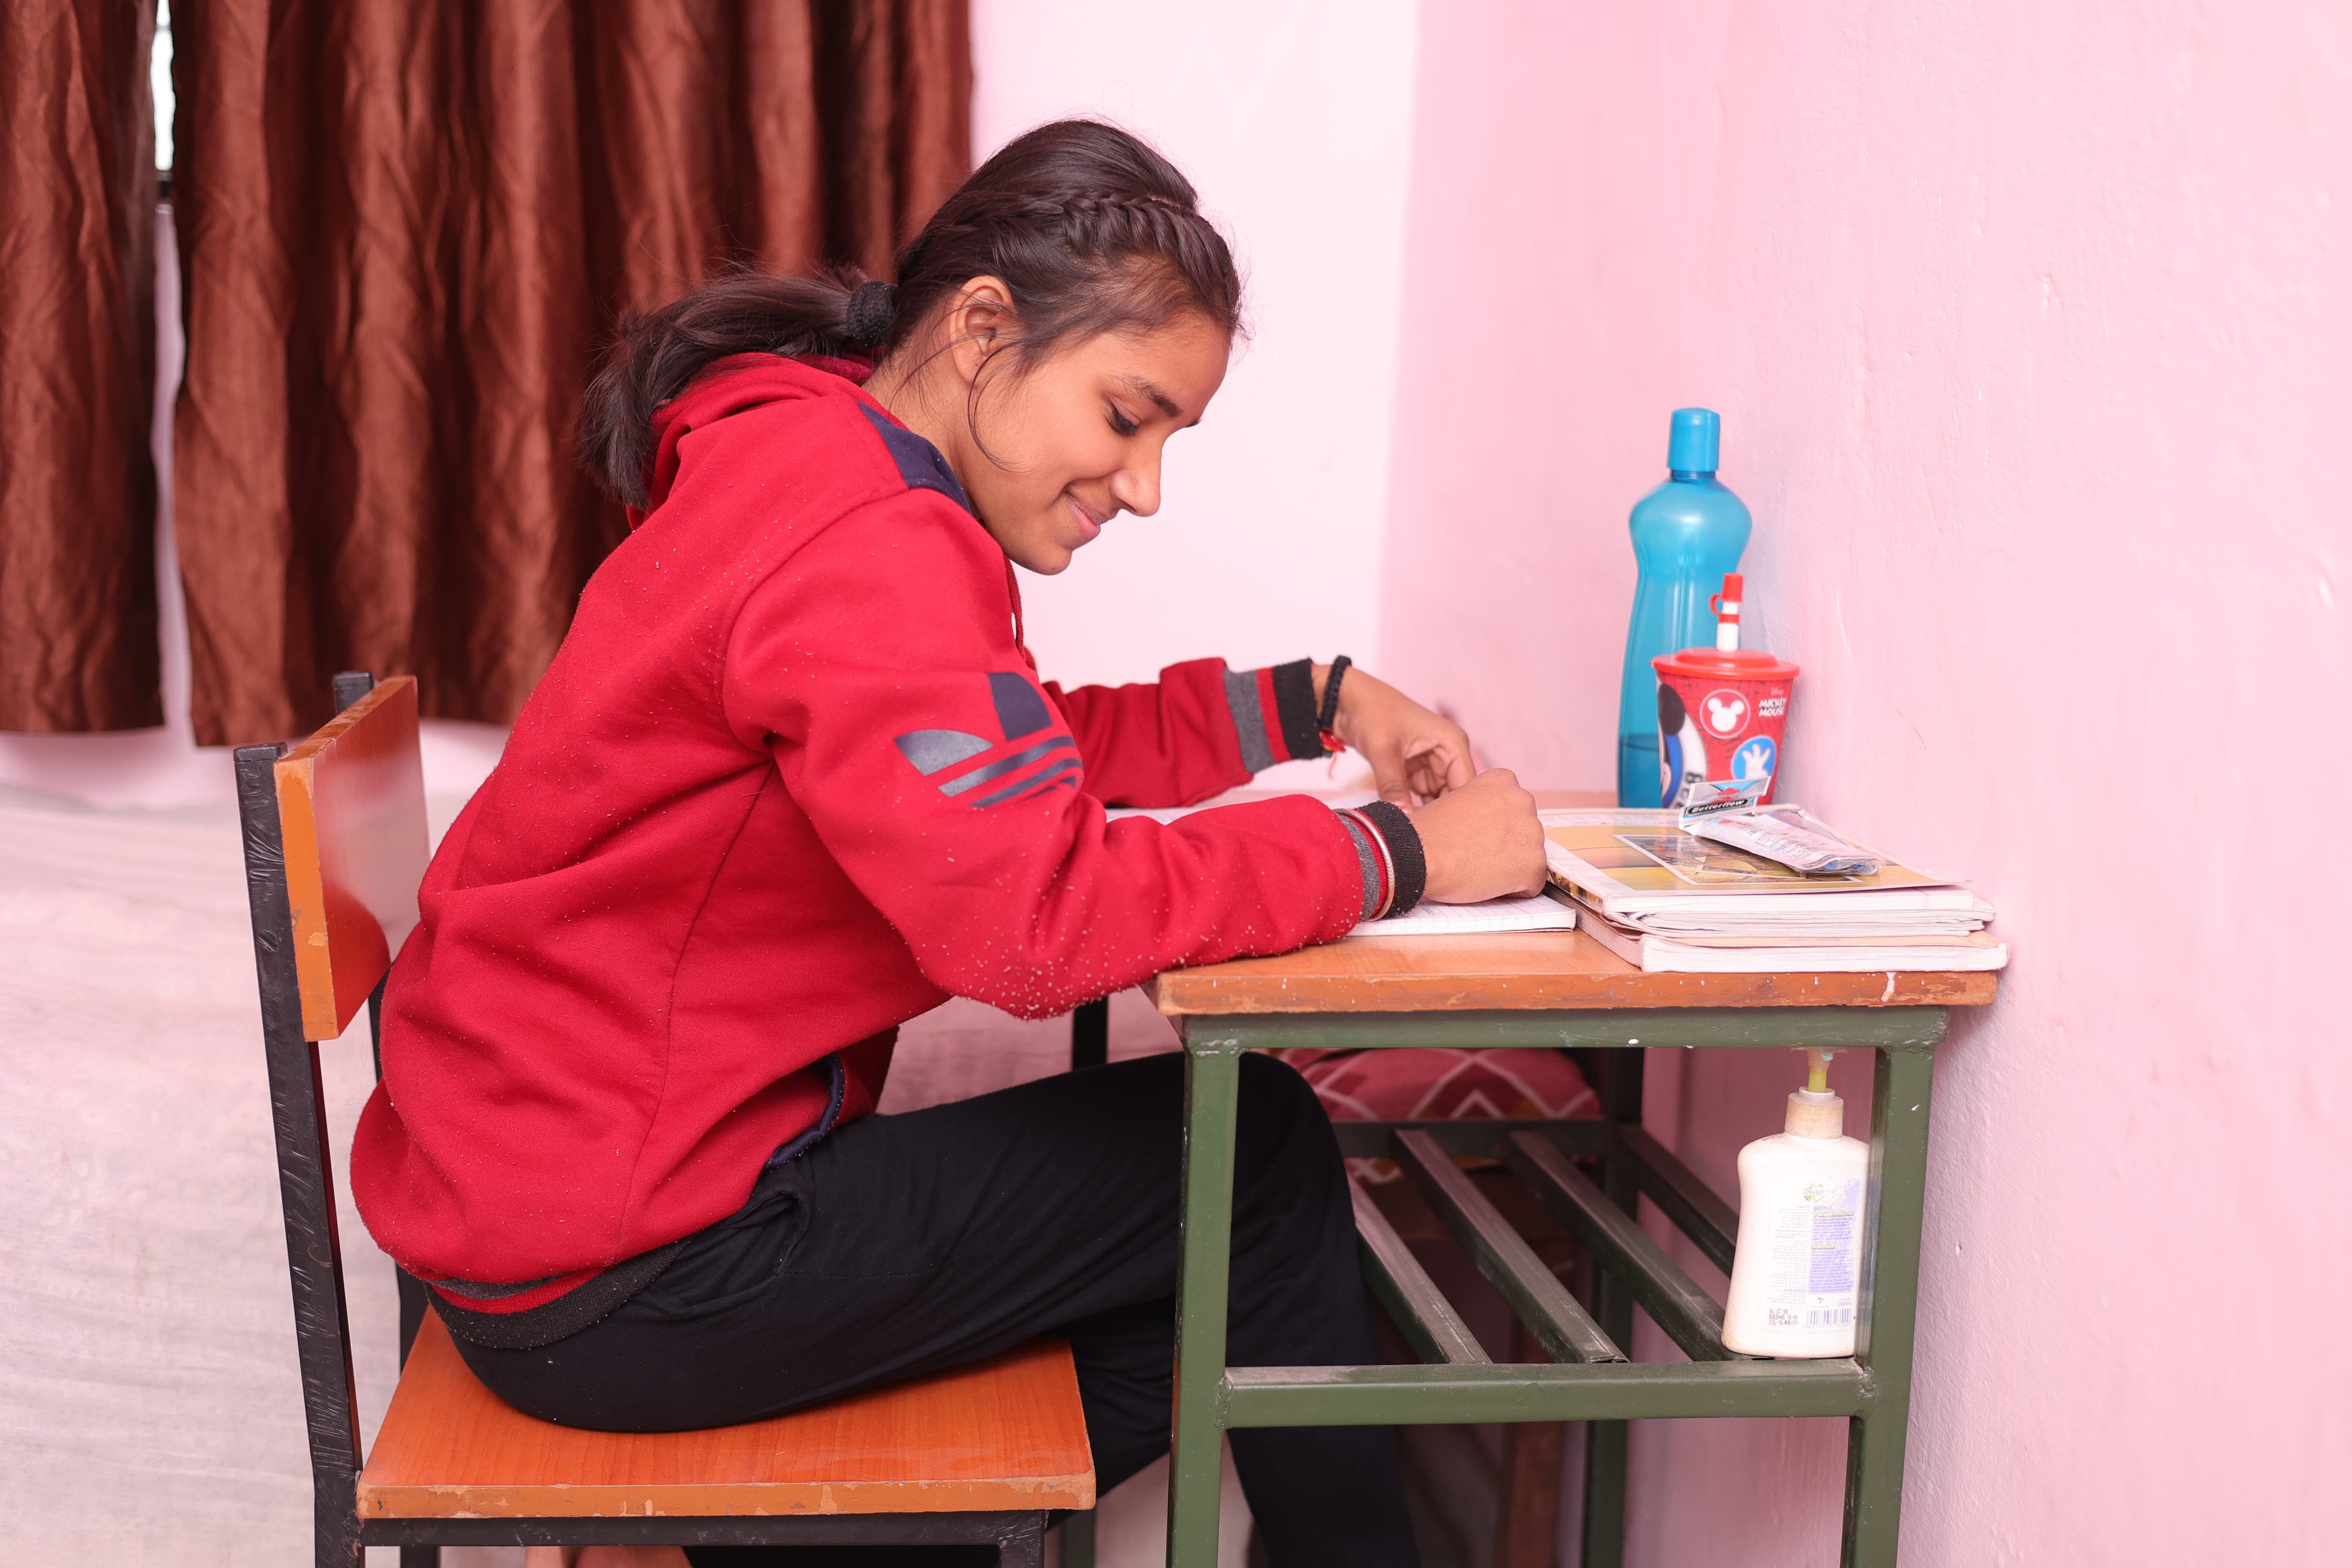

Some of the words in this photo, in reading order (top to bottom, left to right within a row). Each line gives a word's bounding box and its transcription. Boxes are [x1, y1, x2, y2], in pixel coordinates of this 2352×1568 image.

[1758, 697, 1786, 708] MICKEY
[1758, 707, 1784, 717] MOUSE
[1691, 799, 1744, 813] Butterflow
